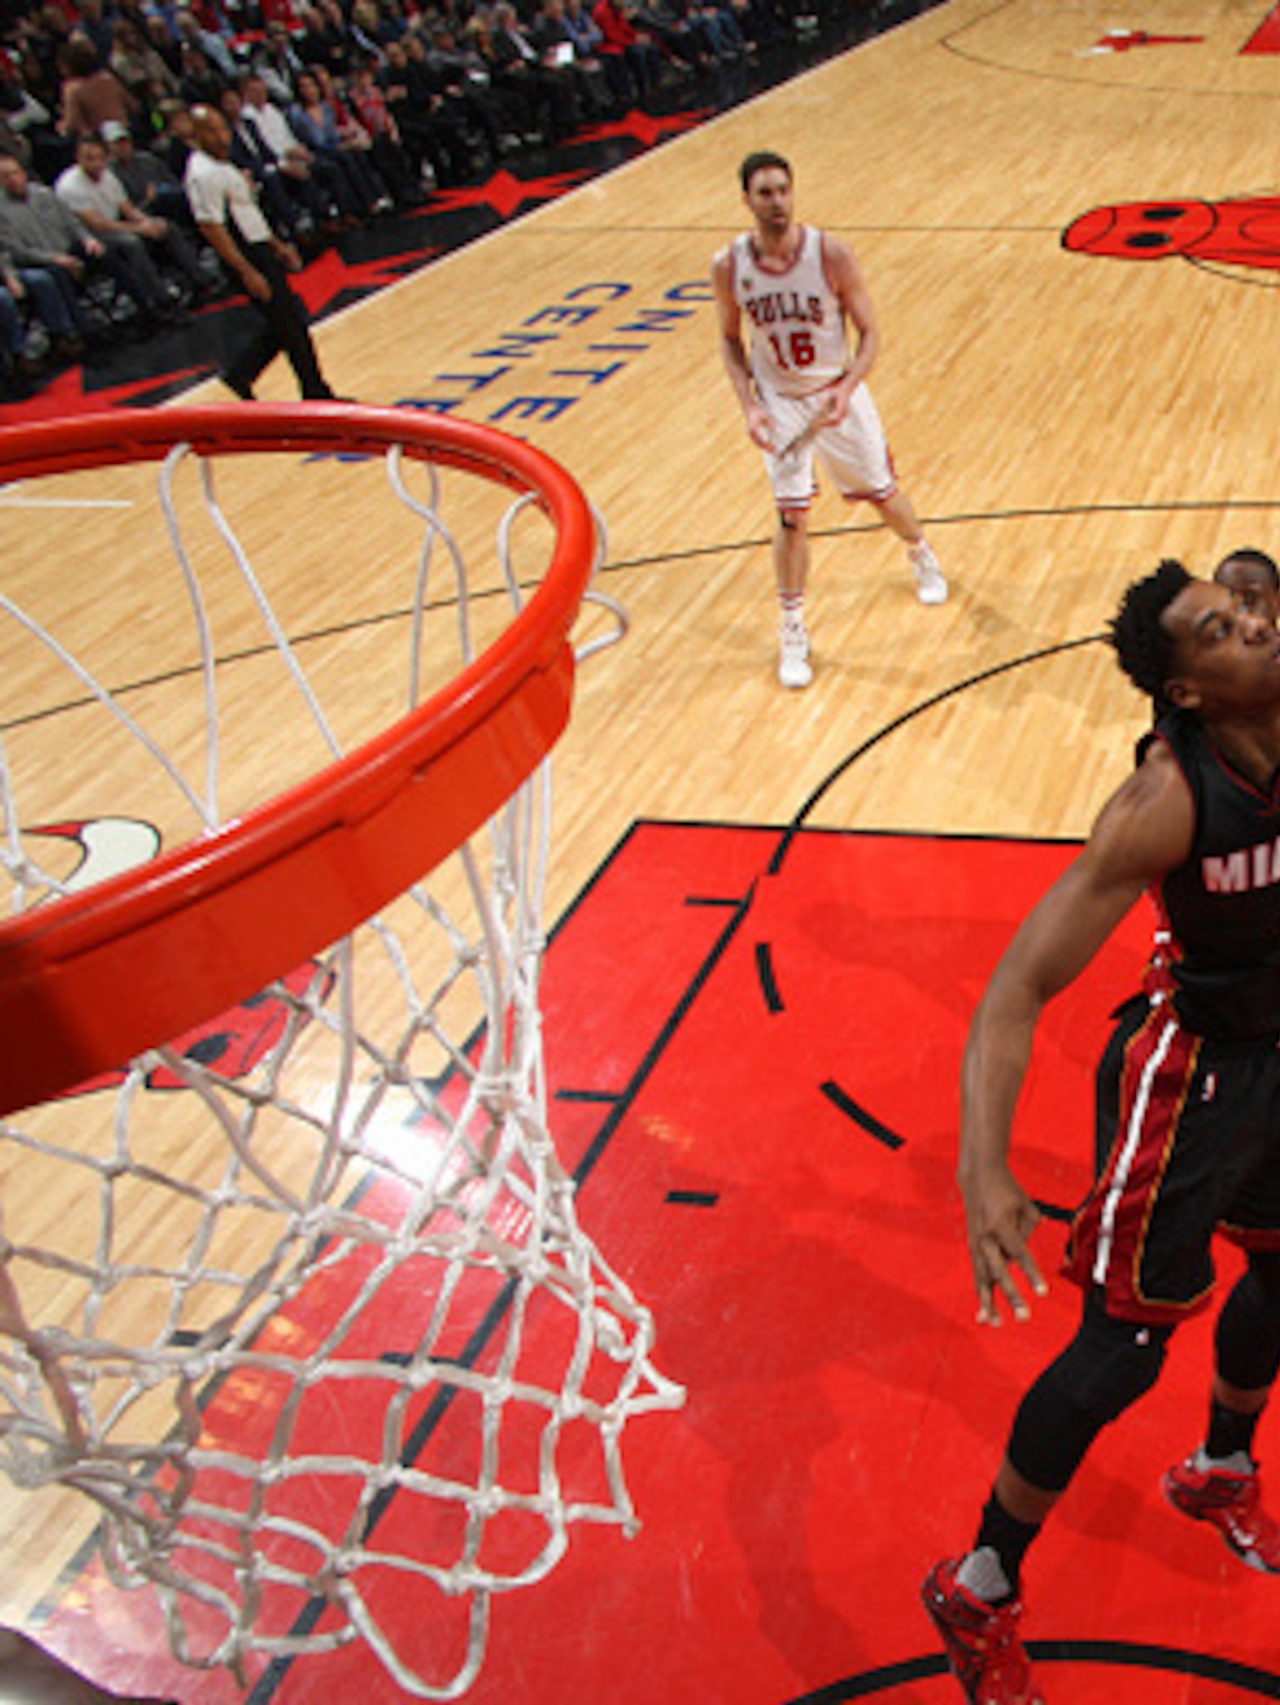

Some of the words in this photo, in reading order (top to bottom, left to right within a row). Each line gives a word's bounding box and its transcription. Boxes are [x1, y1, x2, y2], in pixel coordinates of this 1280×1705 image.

[745, 291, 824, 328] BULLS
[488, 282, 715, 440] UNITE
[768, 331, 815, 370] 16
